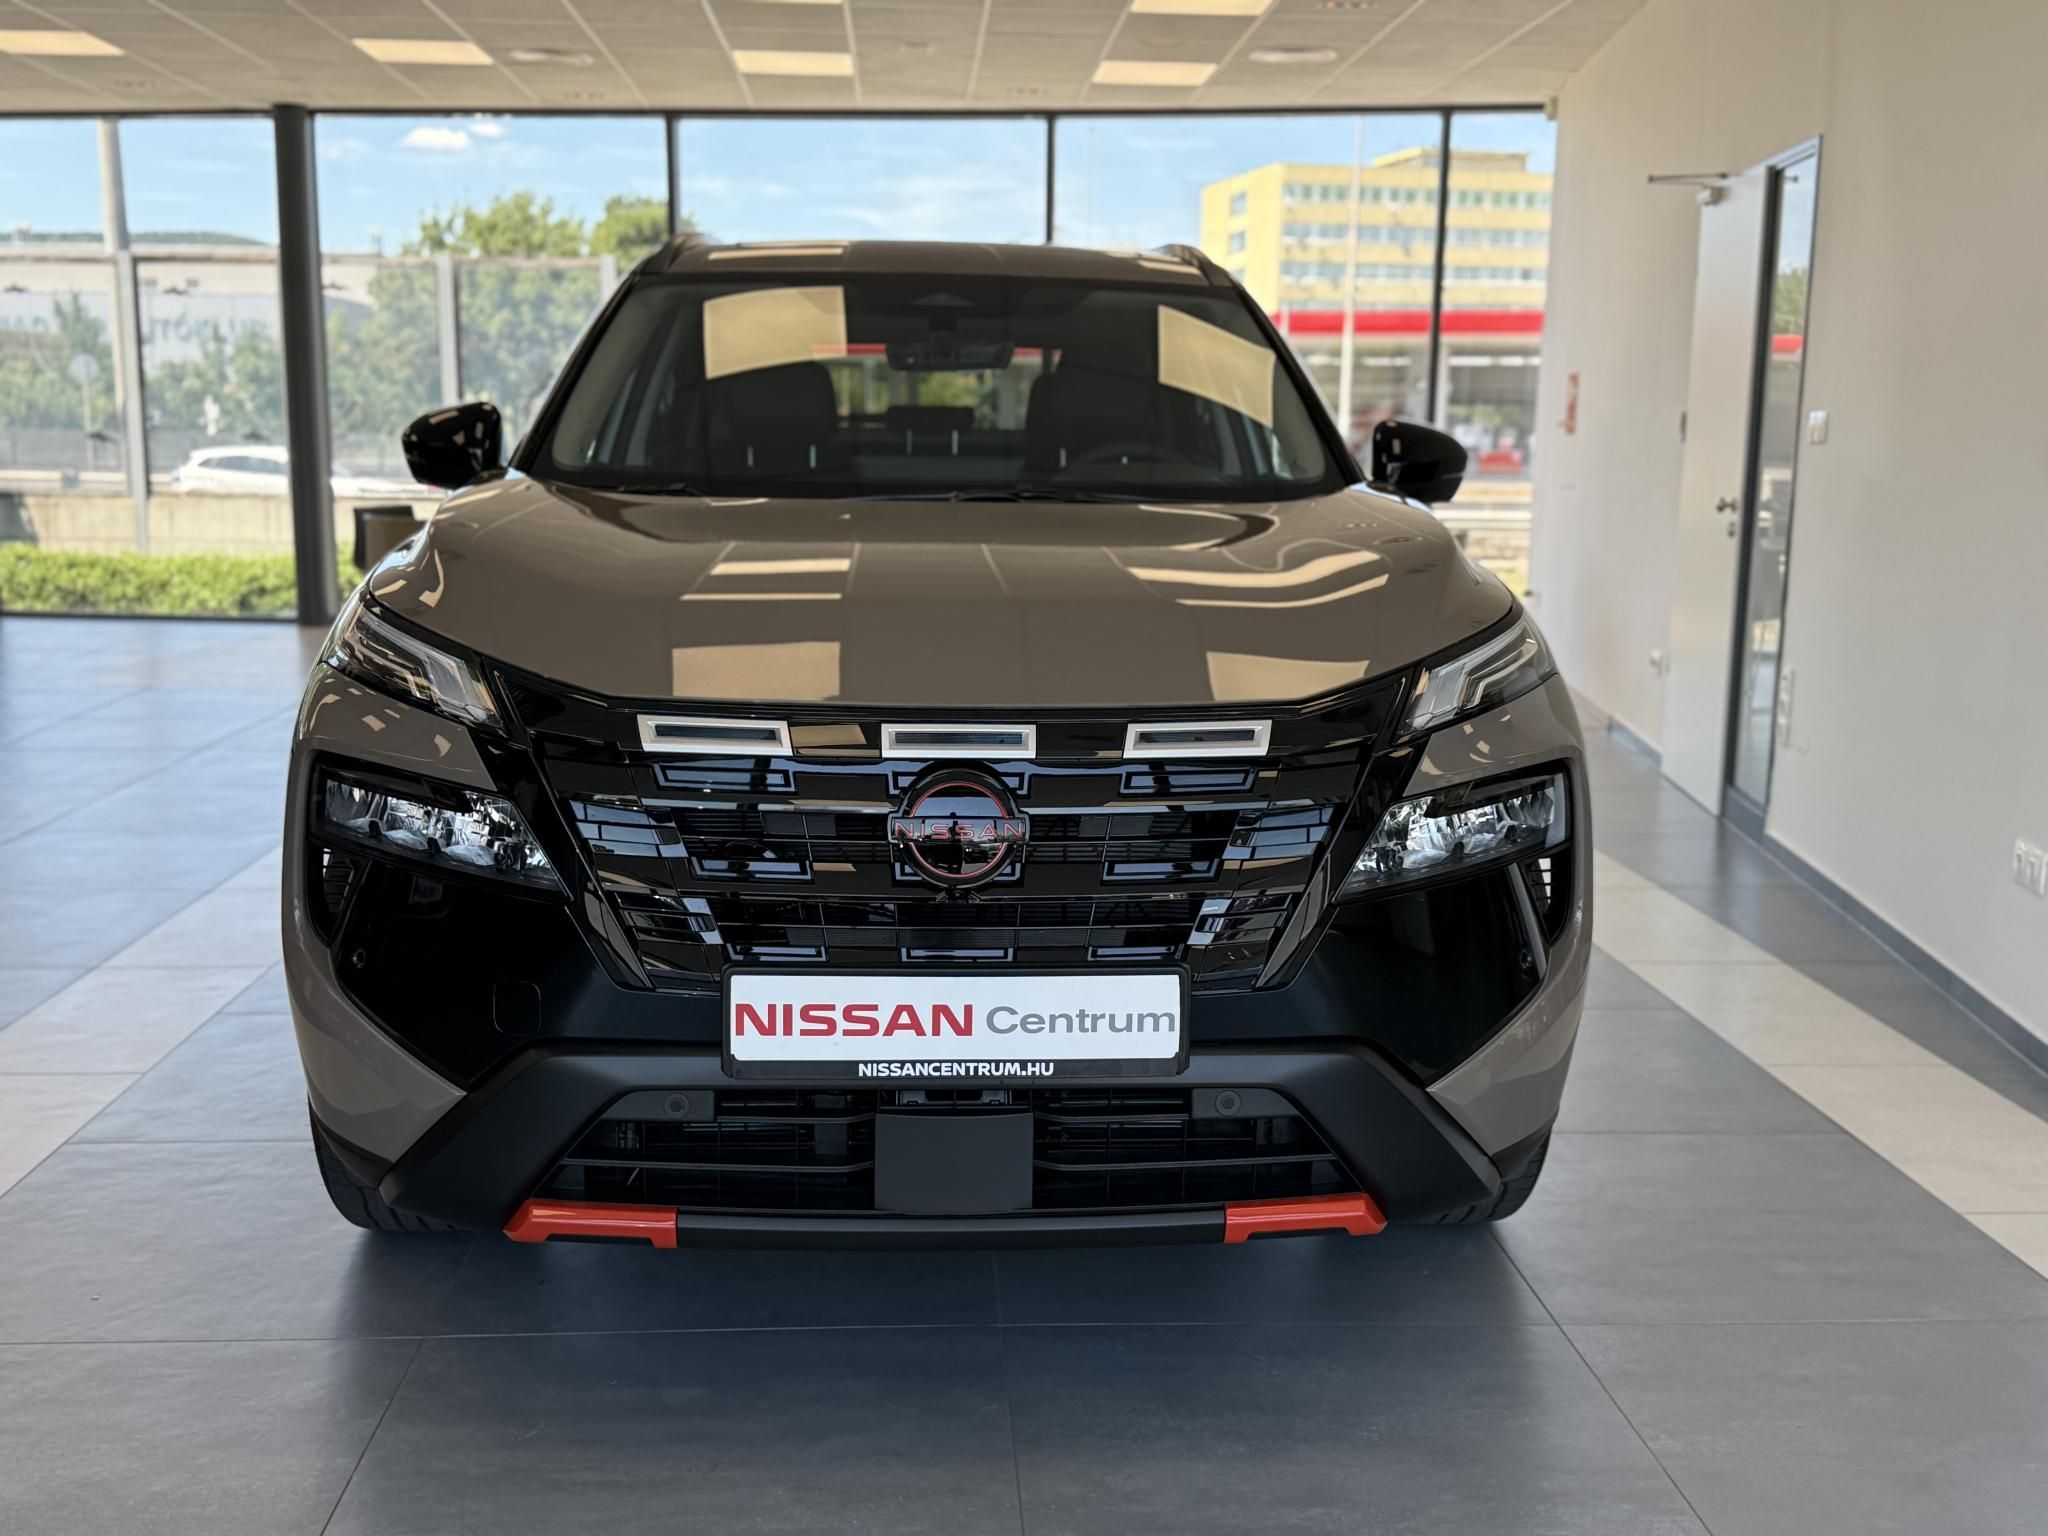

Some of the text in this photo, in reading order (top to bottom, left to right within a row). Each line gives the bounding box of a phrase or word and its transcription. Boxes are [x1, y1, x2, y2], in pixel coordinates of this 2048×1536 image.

[893, 822, 1024, 840] NISSAN
[735, 1003, 1176, 1037] NISSAN Centrum
[858, 1060, 1055, 1077] NISSANCENTRUM.HU
